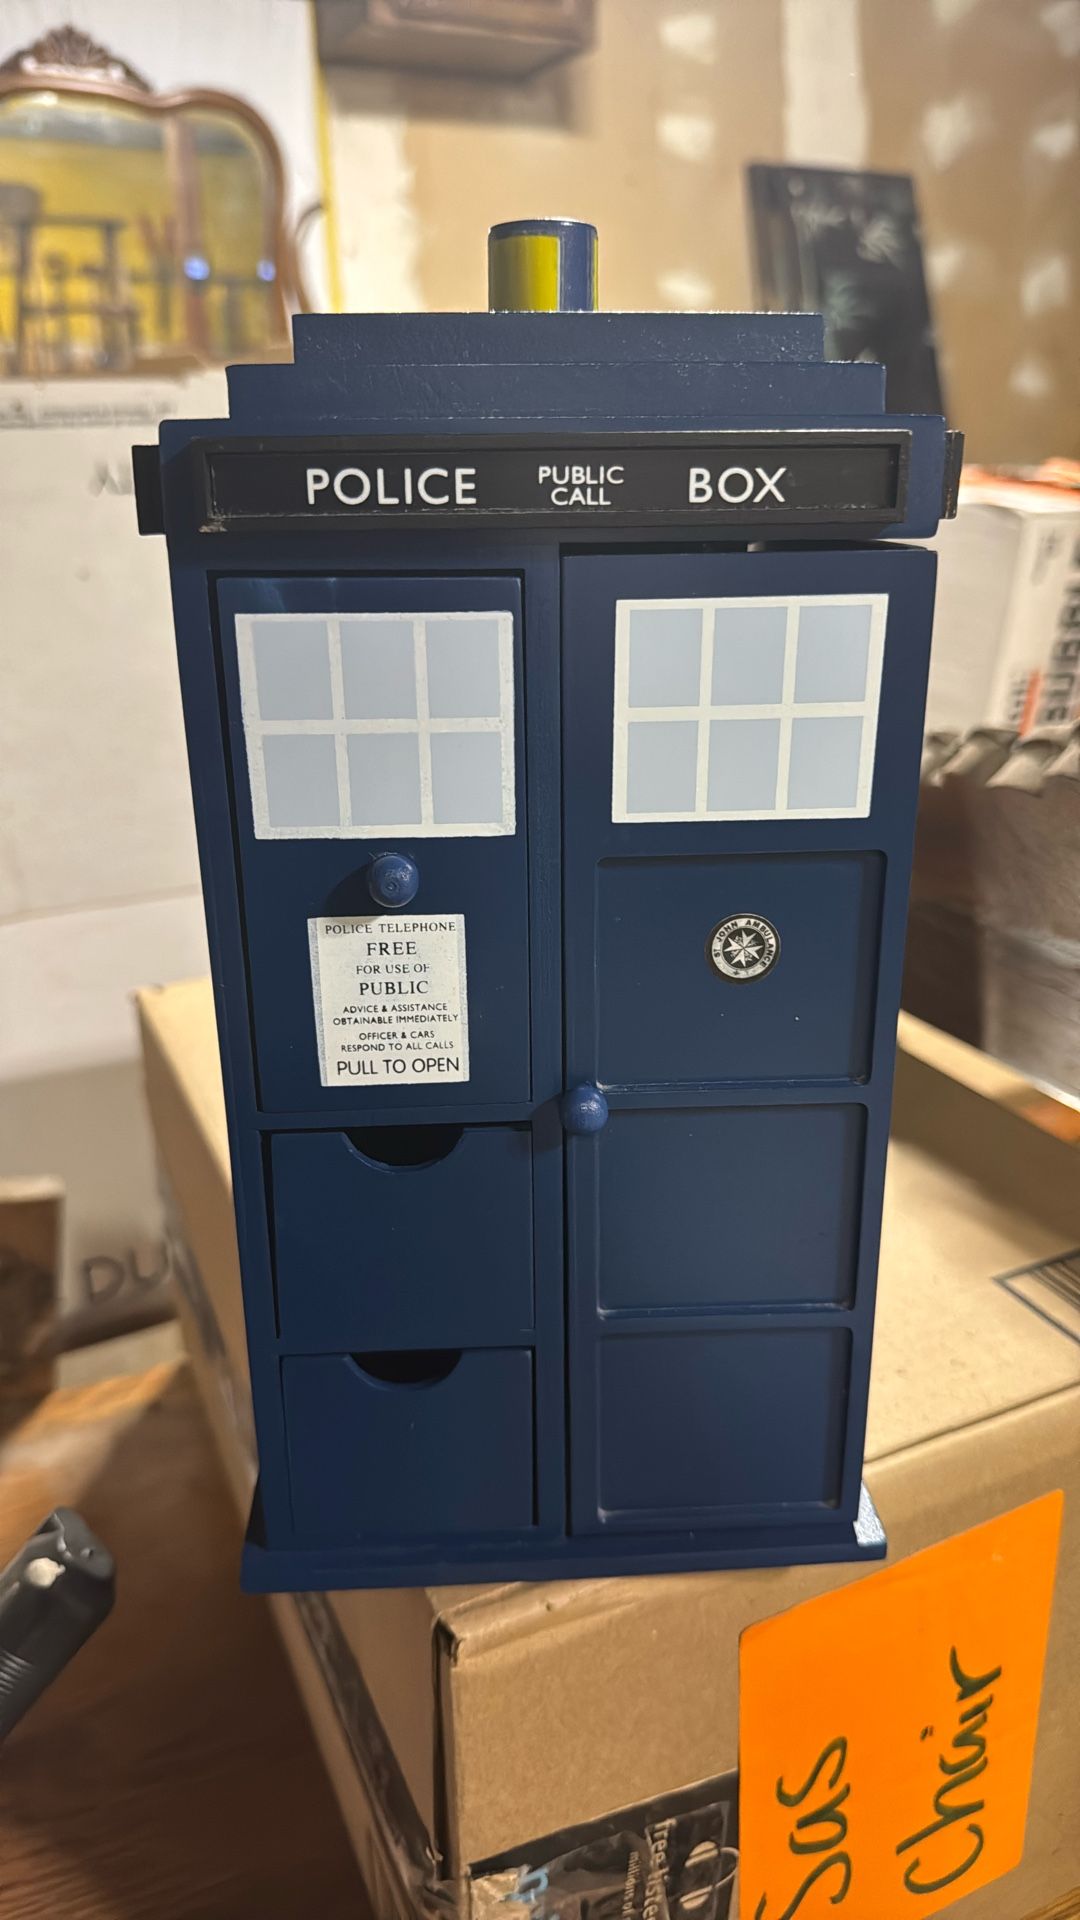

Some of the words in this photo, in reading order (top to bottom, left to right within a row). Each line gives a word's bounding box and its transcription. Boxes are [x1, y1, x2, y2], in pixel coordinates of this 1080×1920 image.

[538, 466, 625, 485] PUBLIC
[306, 467, 478, 505] POLICE
[688, 467, 786, 504] BOX
[550, 487, 611, 506] CALL
[325, 924, 373, 935] POLICE
[378, 922, 456, 933] TELEPHONE
[366, 941, 417, 956] FREE
[716, 921, 739, 942] JOHN
[745, 919, 774, 968] AMBULANCE
[356, 965, 381, 974] FOR
[385, 964, 409, 974] USE
[413, 963, 430, 973] OF
[359, 981, 429, 995] PUBLIC
[343, 1004, 379, 1014] ADVICE
[391, 1003, 448, 1013] ASSISTANCE
[333, 1015, 393, 1025] OBTAINABLE
[396, 1014, 458, 1023] IMMEDIATELY
[359, 1032, 397, 1041] OFFICER
[410, 1031, 435, 1039] CARS
[341, 1043, 385, 1052] RESPOND
[388, 1043, 402, 1051] TO
[405, 1042, 422, 1050] ALL
[425, 1041, 454, 1050] CALLS
[337, 1060, 378, 1076] PULL
[383, 1059, 407, 1074] TO
[411, 1057, 460, 1073] OPEN
